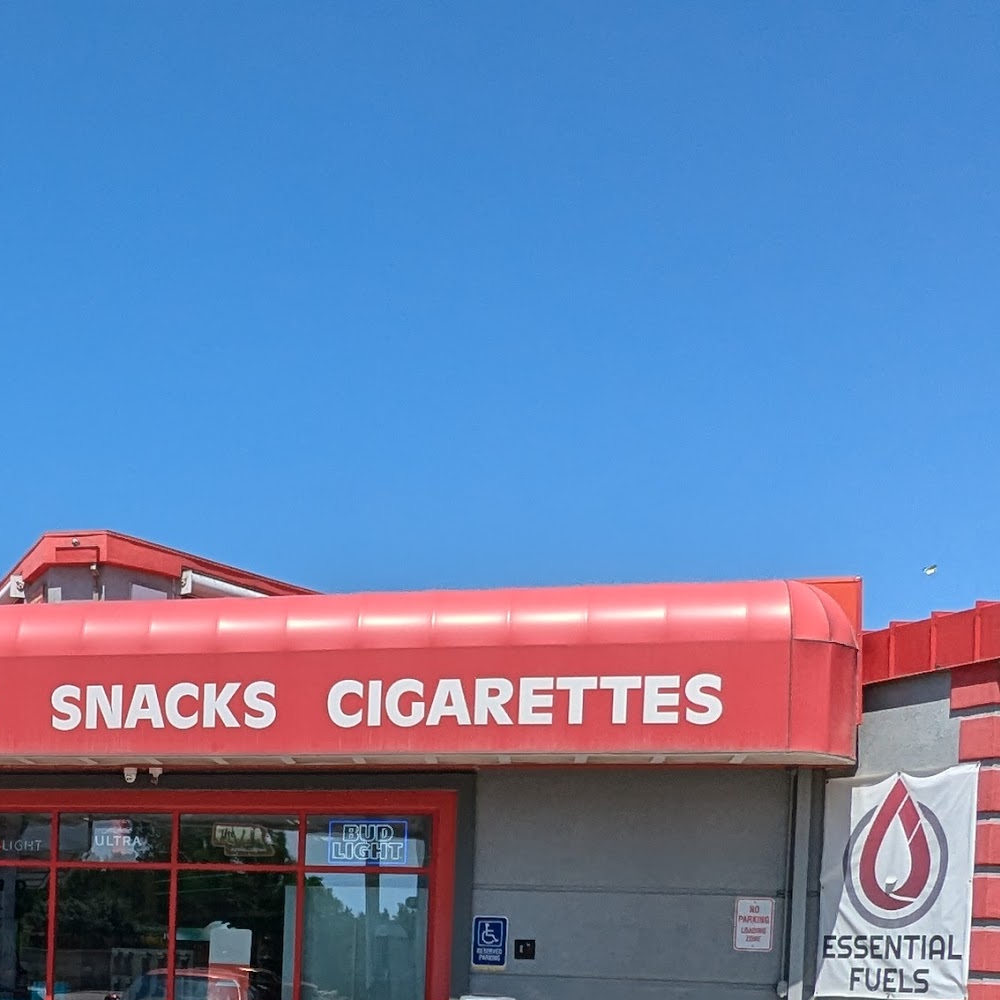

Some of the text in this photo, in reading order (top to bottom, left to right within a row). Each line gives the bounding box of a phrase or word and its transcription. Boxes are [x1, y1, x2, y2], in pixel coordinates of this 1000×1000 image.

[51, 681, 277, 731] SNACKS
[327, 674, 723, 728] CIGARETTES
[342, 824, 394, 842] BUD
[2, 839, 42, 852] LIGHT
[94, 835, 142, 847] ULTRA
[332, 841, 404, 860] LIGHT
[749, 905, 760, 914] NO
[738, 915, 770, 924] PARKING
[476, 947, 503, 955] RESERVED
[823, 935, 963, 960] ESSENTIAL
[478, 954, 501, 962] PARKING
[850, 967, 930, 993] FUELS
